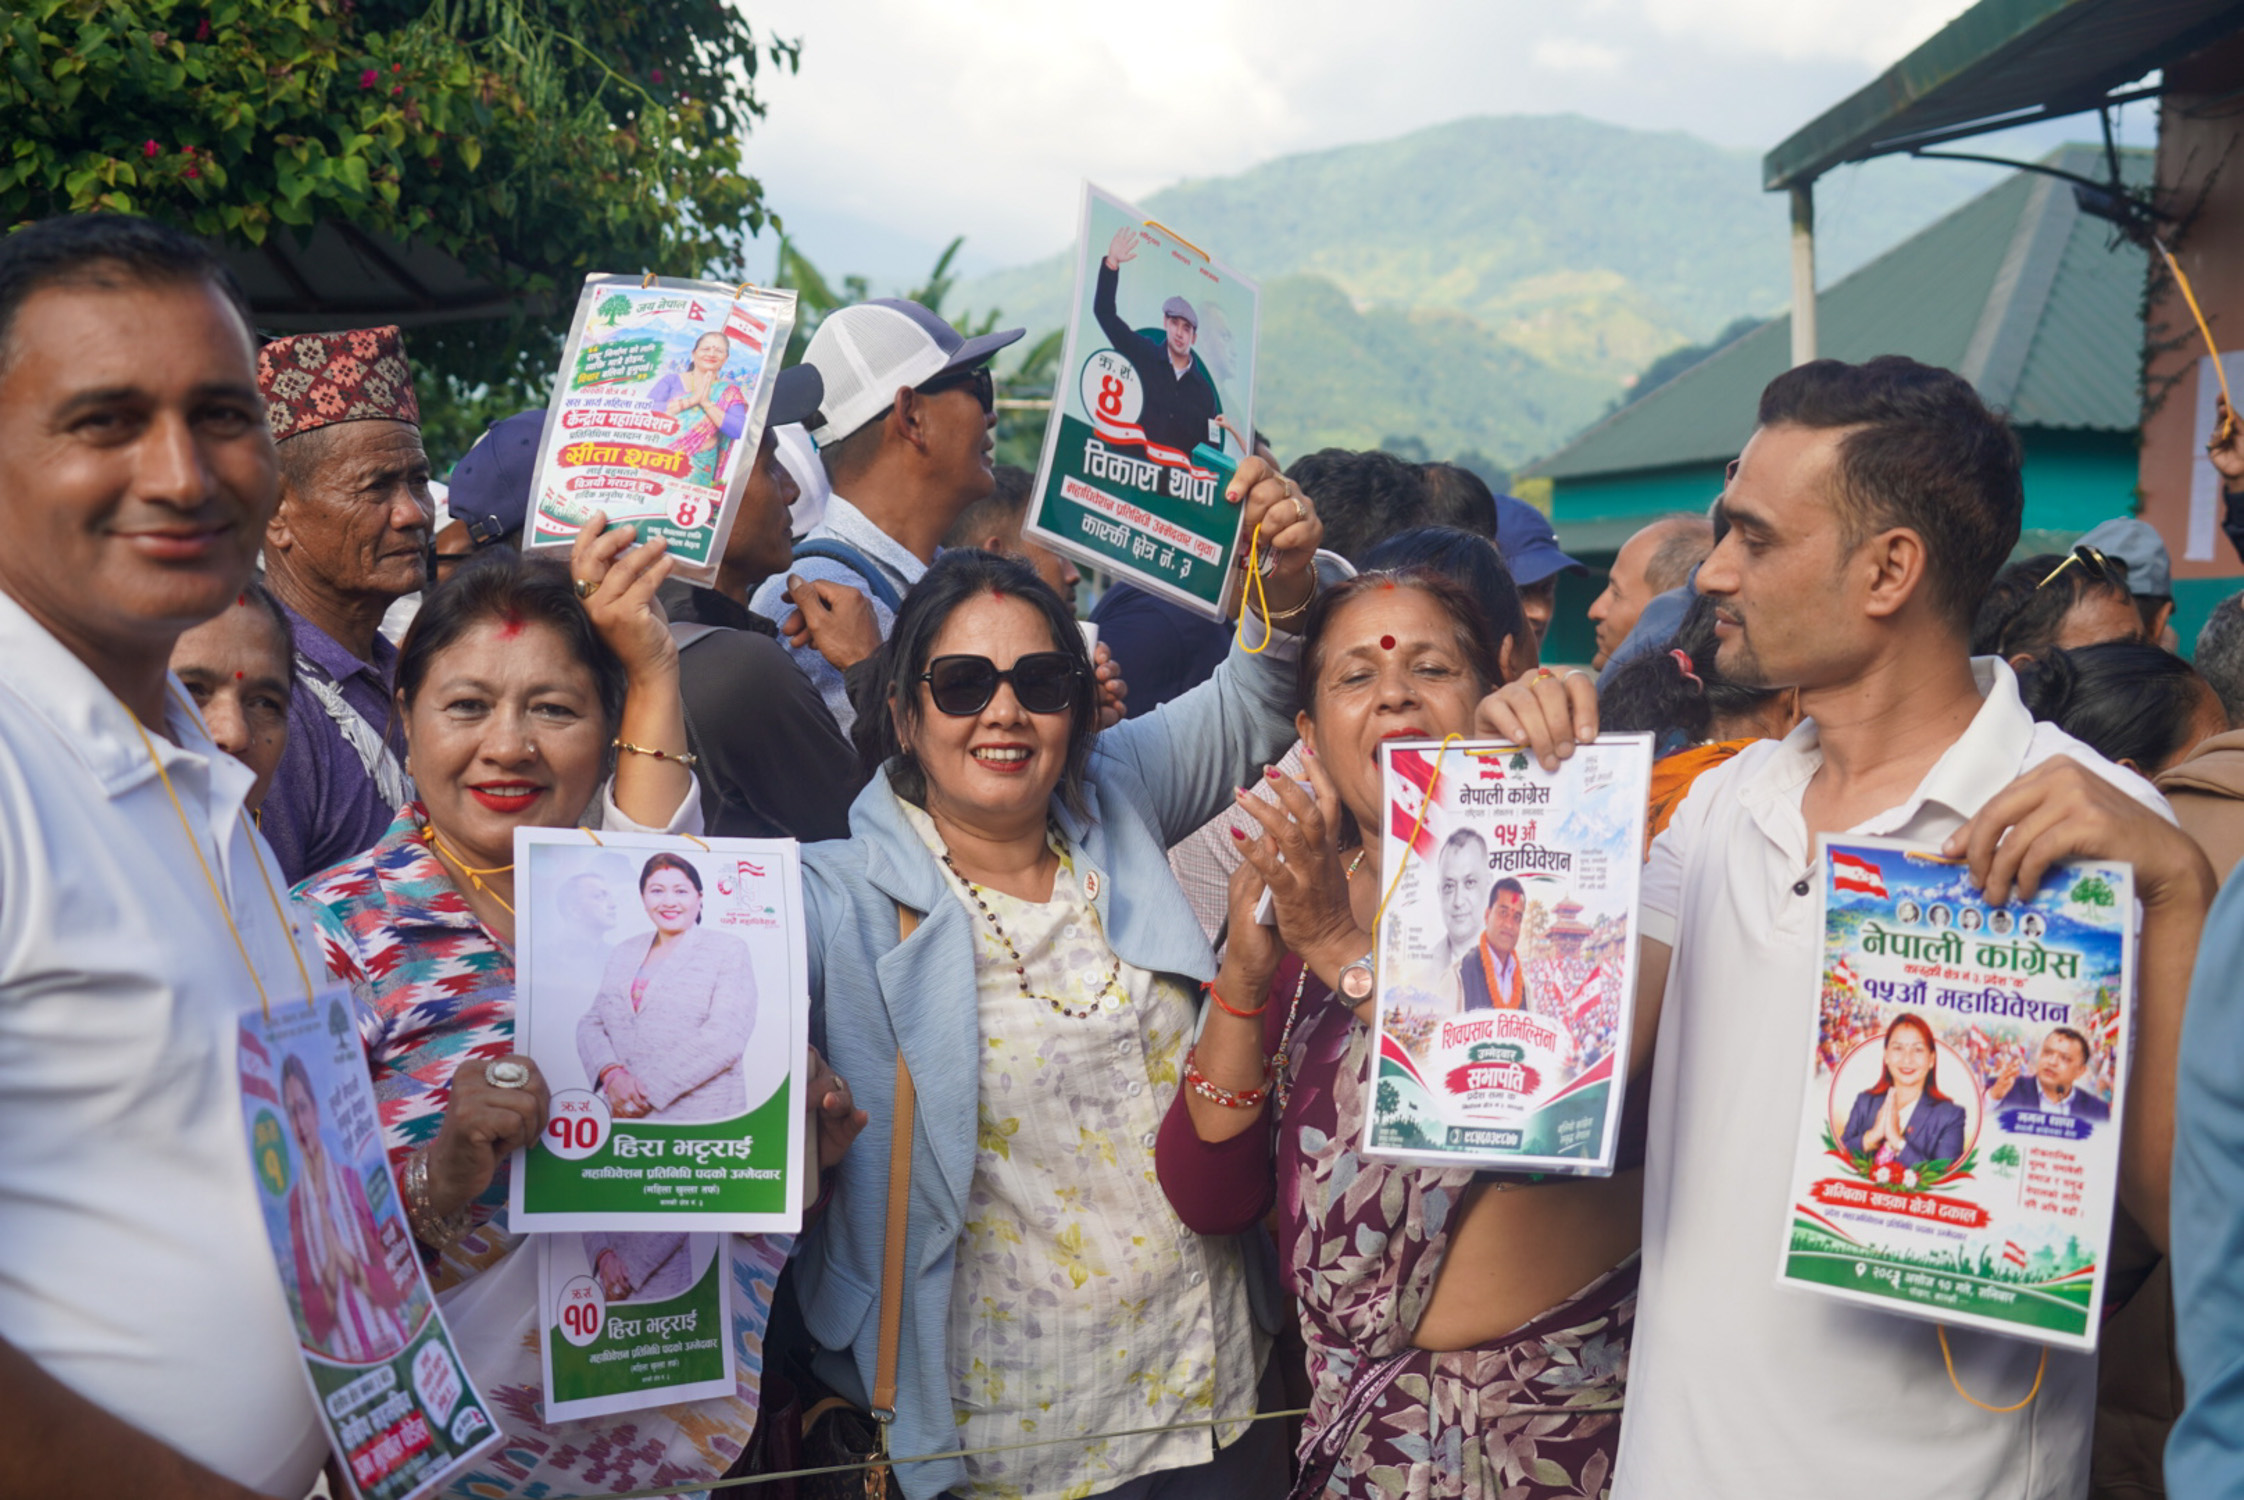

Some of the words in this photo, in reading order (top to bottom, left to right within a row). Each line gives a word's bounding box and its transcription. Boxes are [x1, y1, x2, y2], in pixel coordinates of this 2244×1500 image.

[636, 302, 656, 313] जय
[657, 297, 687, 309] नेपाल
[604, 397, 633, 408] महिला
[1098, 374, 1124, 416] ४
[608, 410, 675, 433] महाधिवेशन
[613, 430, 643, 440] मतदान
[566, 442, 622, 466] सीता
[623, 447, 684, 472] शर्मा
[1084, 437, 1163, 493] विकास
[1168, 466, 1219, 507] थापा
[676, 502, 697, 526] ४
[1066, 481, 1115, 512] महाधिवेशन
[1194, 538, 1217, 560] (युवा)
[1081, 512, 1131, 549] कास्की
[1133, 533, 1158, 562] क्षेत्र
[1160, 547, 1176, 571] नं.
[1180, 557, 1193, 579] ३
[1459, 783, 1504, 805] नेपाली
[1507, 782, 1551, 805] कांग्रेस
[1494, 823, 1518, 847] १५
[1488, 843, 1572, 872] महाधिवेशन
[1862, 921, 1965, 965] नेपाली
[1975, 938, 2081, 980] कांग्रेस
[1935, 987, 2071, 1024] महाधिवेशन
[1442, 1021, 1494, 1050] शिवप्रसाद
[1496, 1013, 1558, 1052] तिमिल्सिना
[1467, 1063, 1526, 1093] सभापति
[547, 1116, 599, 1149] १०
[612, 1133, 665, 1158] हिरा
[672, 1134, 754, 1165] भट्टराई
[263, 1147, 285, 1190] १
[581, 1166, 643, 1180] महाधिवेशन
[646, 1166, 692, 1180] प्रतिनिधि
[695, 1166, 728, 1179] पदको
[729, 1166, 782, 1181] उम्मेदवार
[643, 1184, 672, 1195] (महिला
[1822, 1182, 1868, 1204] अम्बिका
[564, 1302, 599, 1337] १०
[607, 1316, 641, 1340] हिरा
[646, 1308, 698, 1340] भट्टराई
[588, 1349, 630, 1364] महाधिवेशन
[662, 1340, 683, 1355] पदको
